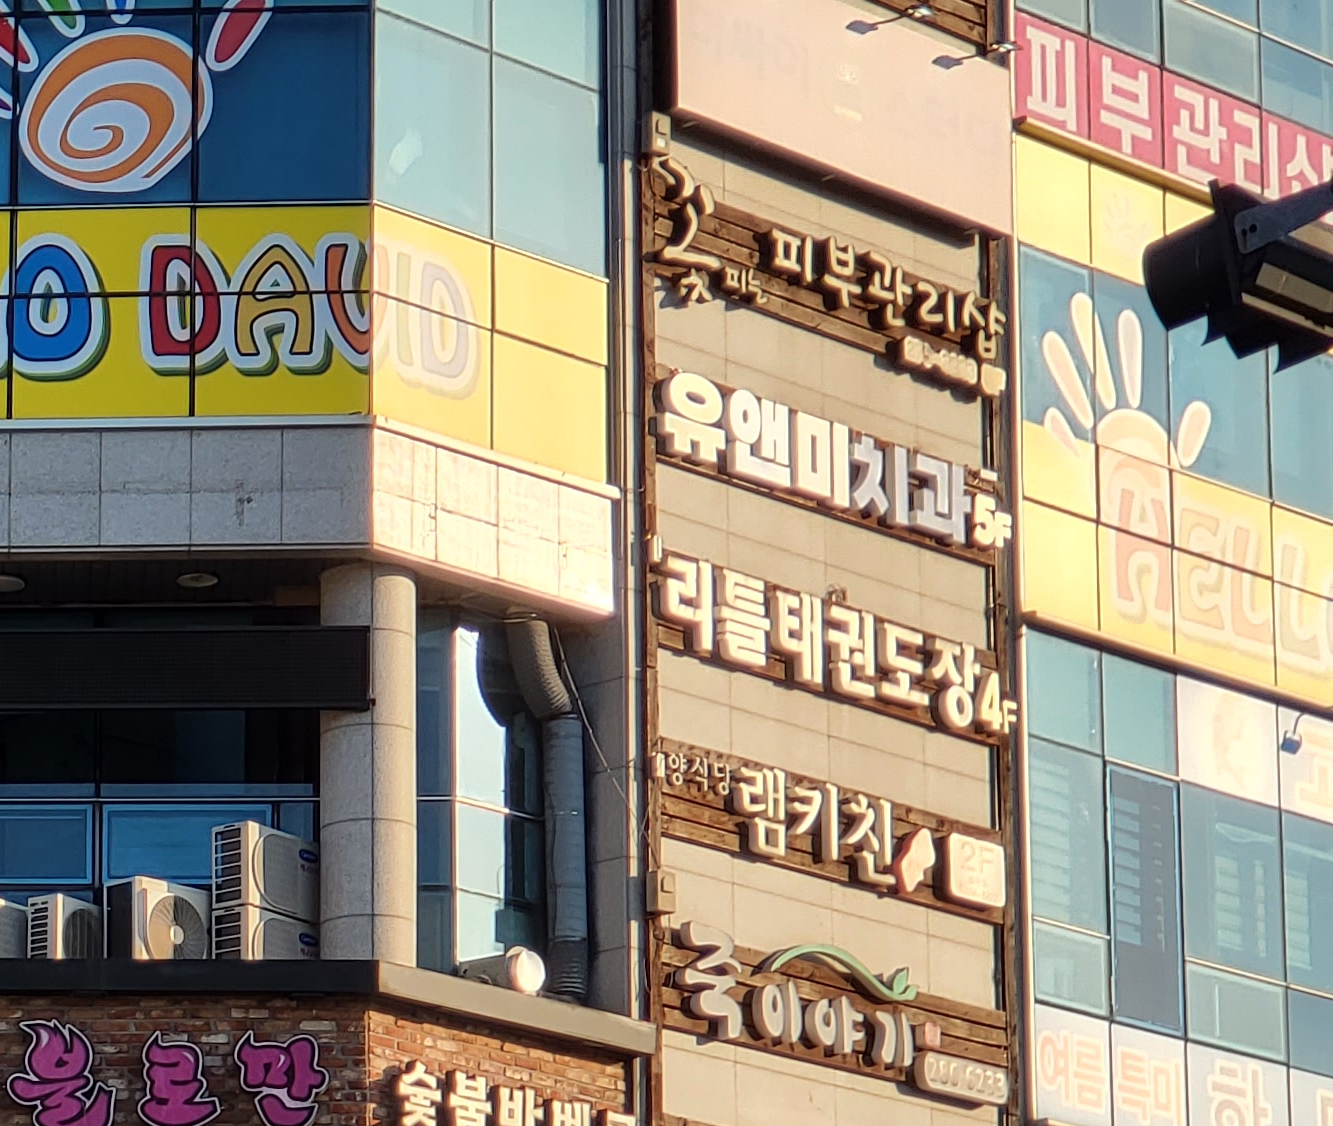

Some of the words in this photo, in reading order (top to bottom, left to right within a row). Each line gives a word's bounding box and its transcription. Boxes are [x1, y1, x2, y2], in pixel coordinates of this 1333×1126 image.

[769, 228, 1007, 360] 피부관리샵
[658, 370, 971, 543] 유앤미치과
[972, 493, 1012, 548] 5F
[661, 555, 981, 731] 리틀태권도장
[978, 673, 1018, 734] 4F
[733, 763, 896, 885] 램키친
[675, 920, 916, 1069] 죽이야기
